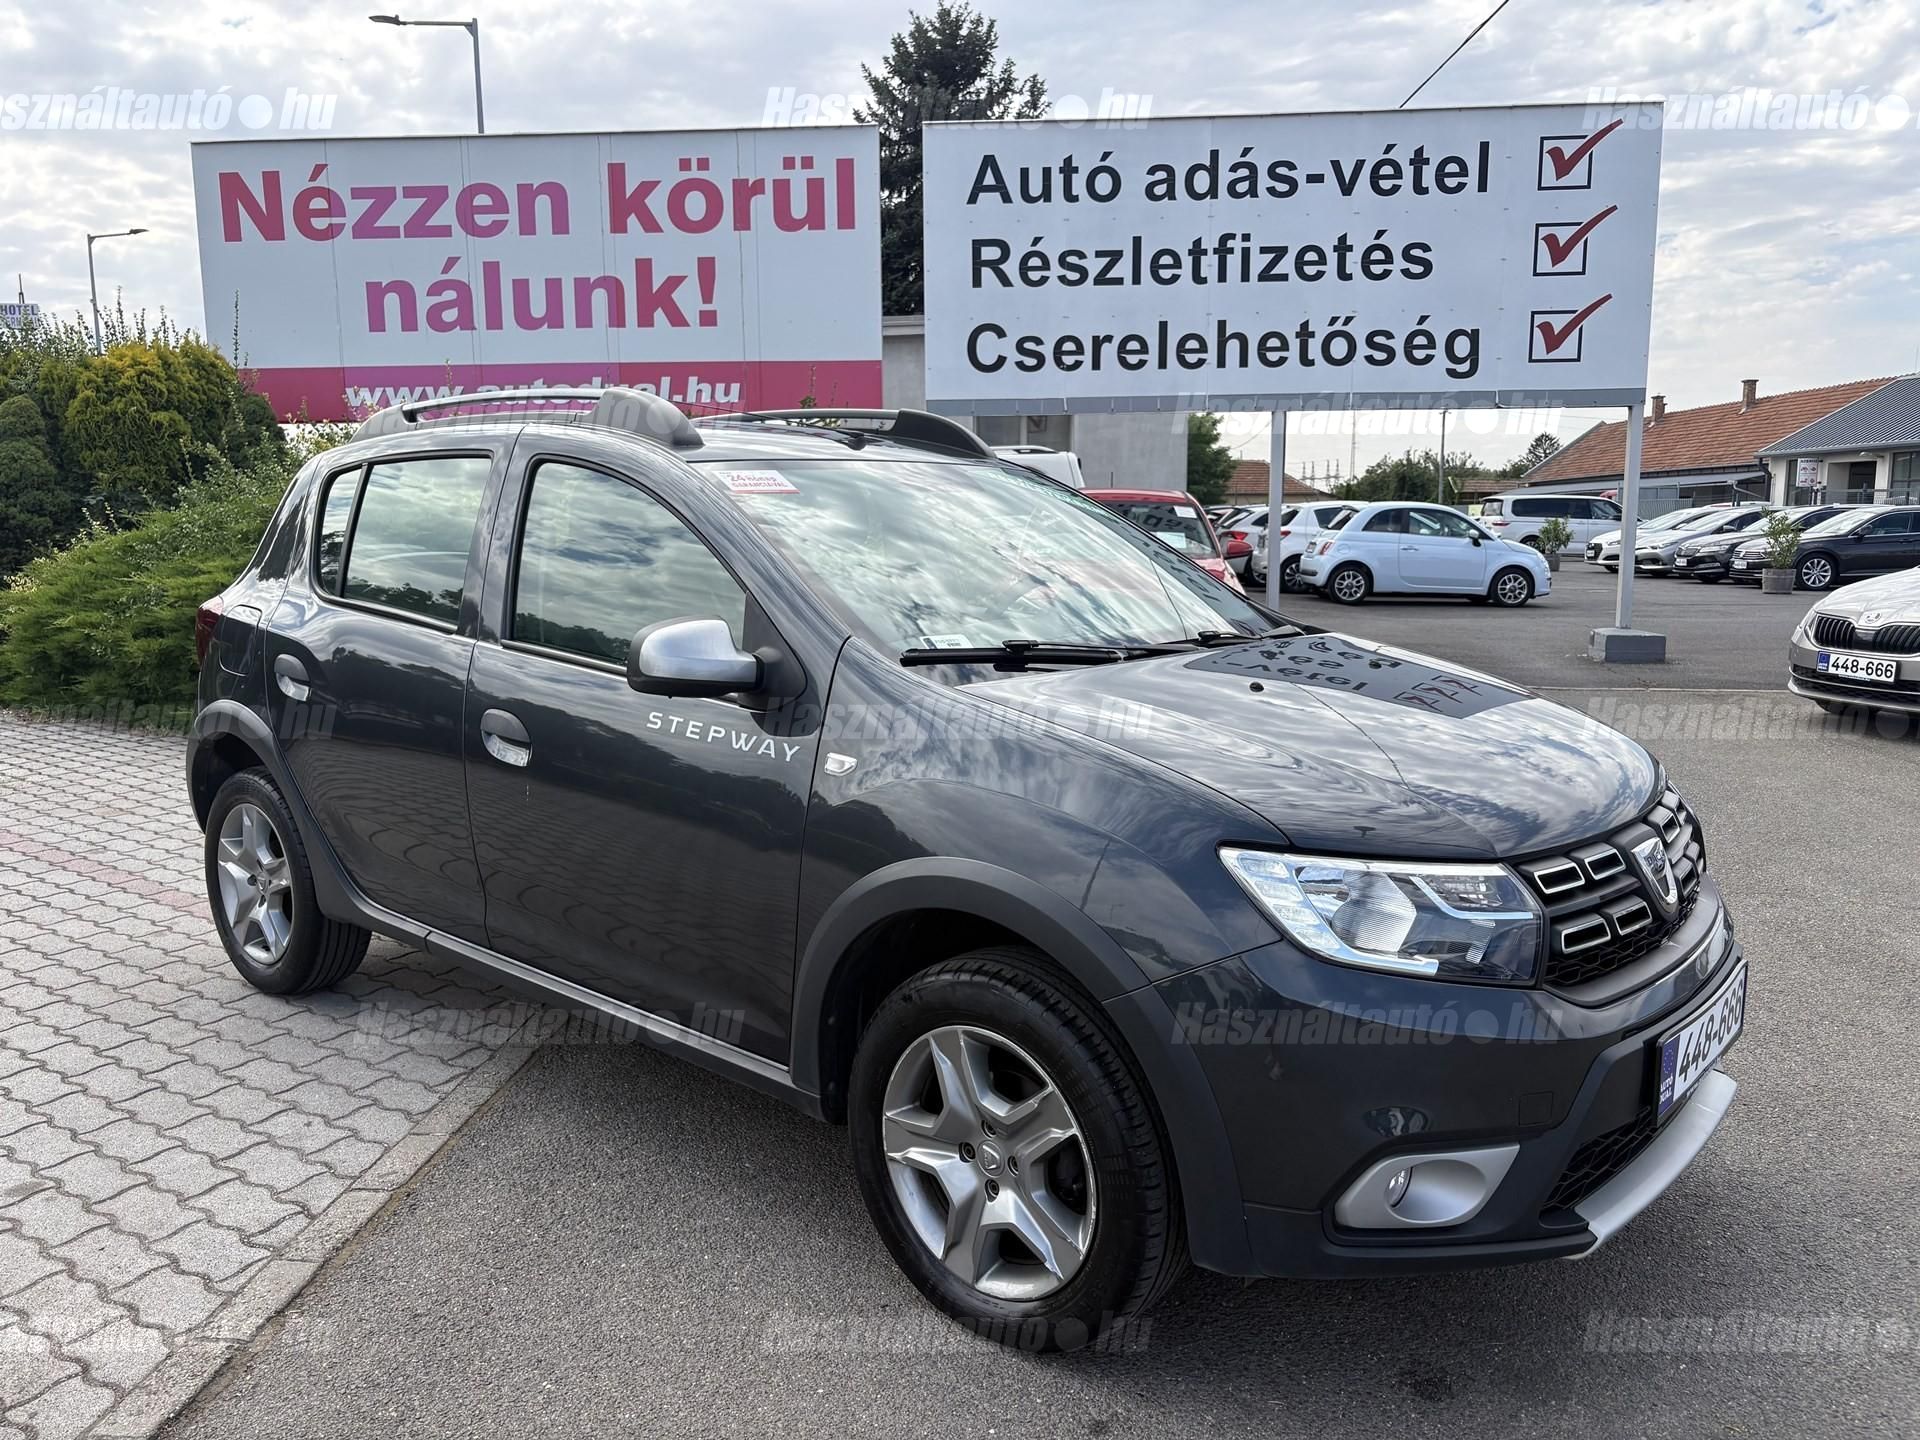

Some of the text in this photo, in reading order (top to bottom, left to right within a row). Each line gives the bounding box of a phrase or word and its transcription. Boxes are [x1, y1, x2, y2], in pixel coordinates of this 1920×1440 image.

[219, 156, 855, 242] Nézzen körül
[966, 140, 1490, 205] Autó adás-vétel
[971, 229, 1434, 289] Részletfizetés
[367, 257, 718, 332] nálunk!
[967, 314, 1481, 380] Cserelehetőség
[1831, 656, 1894, 679] 448-666
[646, 711, 801, 762] STEPWAY
[1678, 978, 1744, 1083] 448-666
